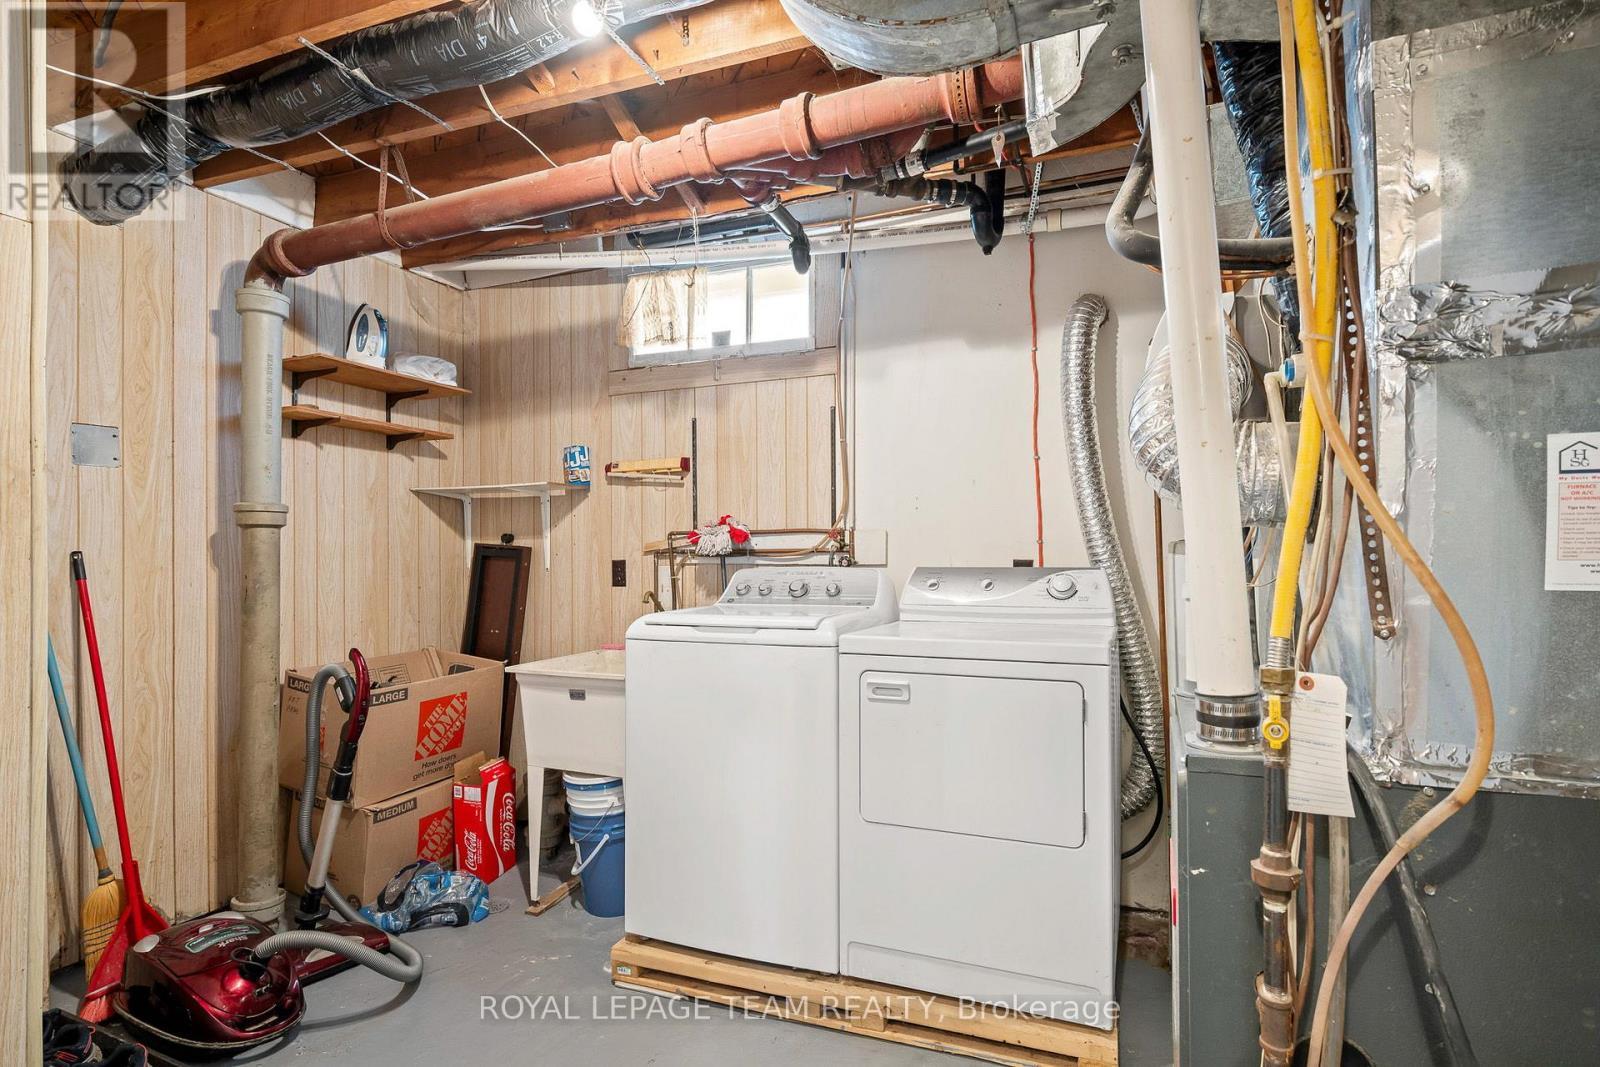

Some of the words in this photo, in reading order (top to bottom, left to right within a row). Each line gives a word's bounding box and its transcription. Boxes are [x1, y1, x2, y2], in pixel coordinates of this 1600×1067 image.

[289, 679, 312, 692] LARG
[372, 690, 405, 704] LARGE
[415, 694, 467, 758] HOME
[423, 703, 445, 731] THE
[434, 712, 466, 755] DEPOT
[412, 772, 425, 782] get
[425, 765, 444, 777] more
[421, 760, 439, 770] How
[439, 754, 457, 765] doers
[377, 800, 415, 821] MEDIUM
[502, 792, 516, 852] Coca-Cola
[463, 828, 478, 871] Coca-Cola
